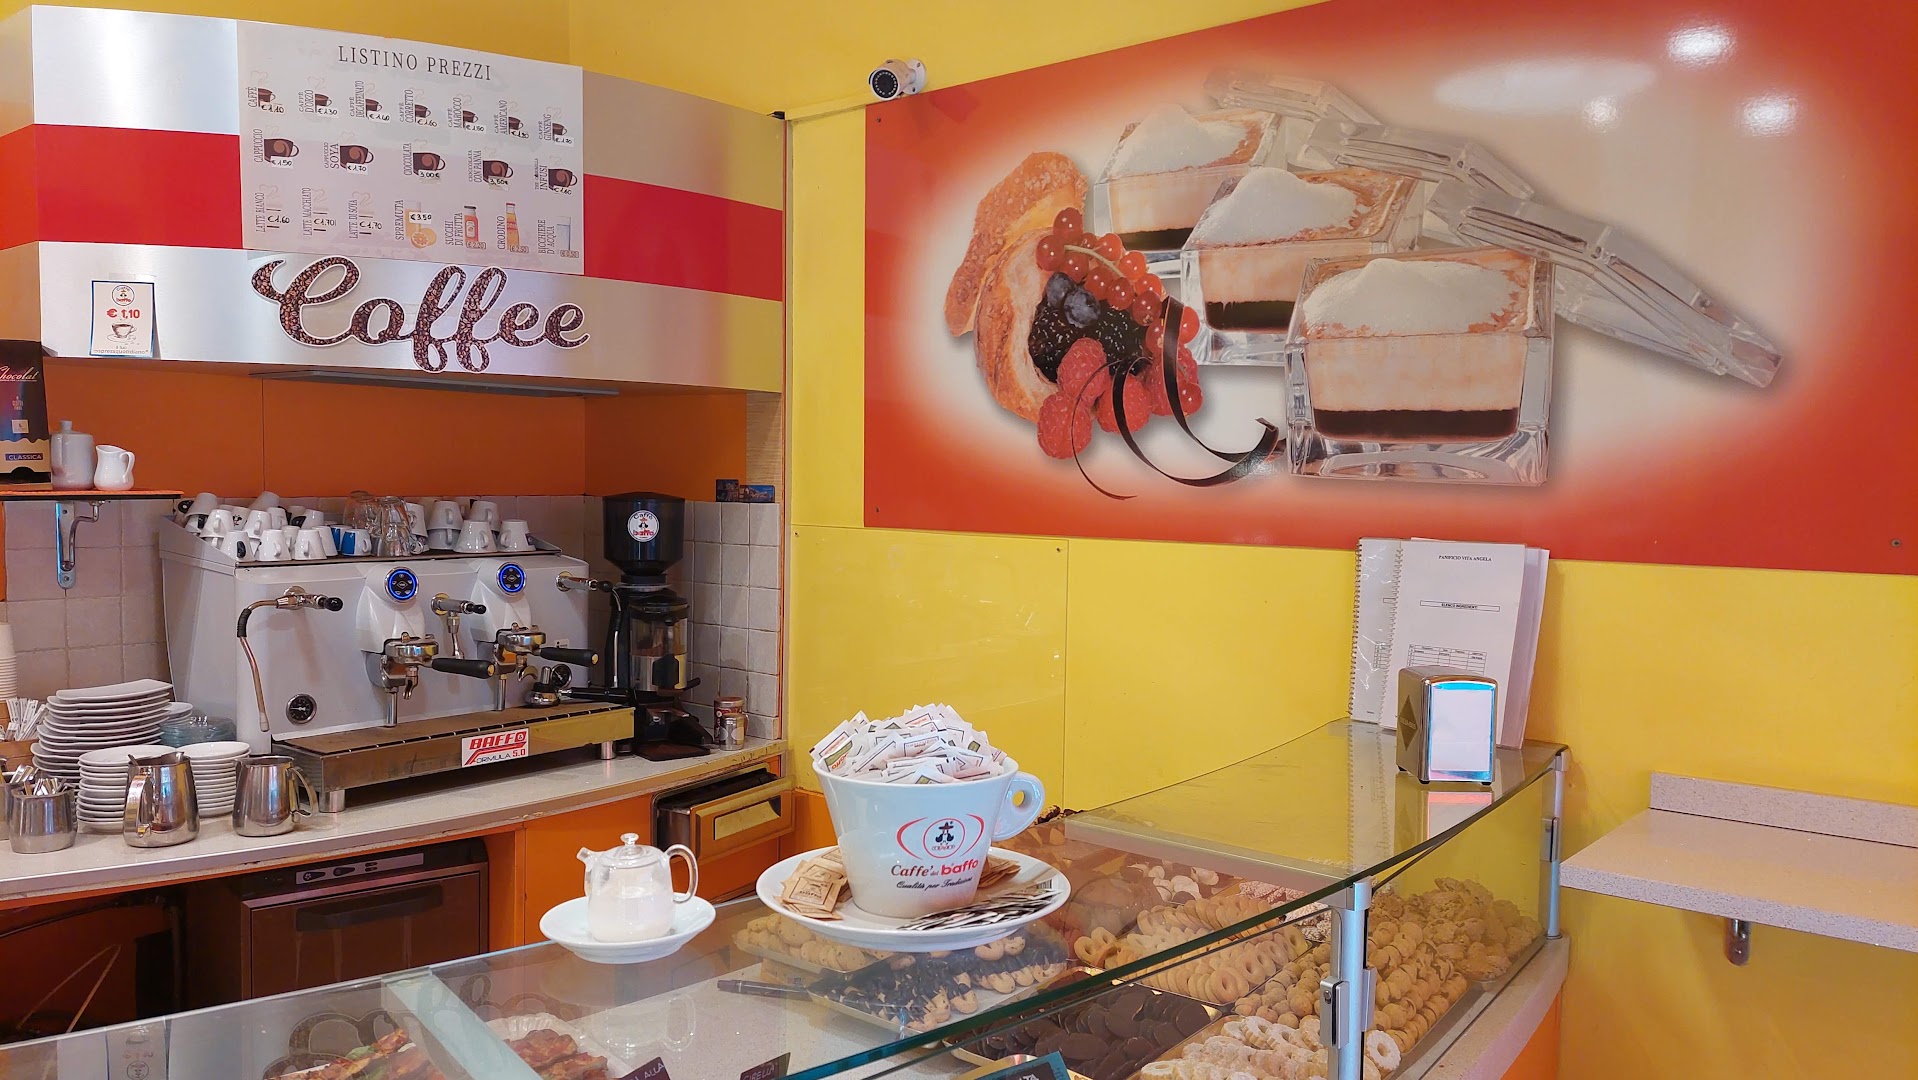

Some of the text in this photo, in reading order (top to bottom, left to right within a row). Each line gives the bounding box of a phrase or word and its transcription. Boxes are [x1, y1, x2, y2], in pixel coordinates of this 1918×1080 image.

[338, 45, 490, 80] LISTINO PREZZI
[355, 80, 365, 118] DECAFFEINATO
[404, 89, 414, 123] CORRETTO
[453, 97, 462, 128] MAROCCO
[499, 100, 508, 135] AMERICANO
[543, 113, 552, 141] GINSENG
[253, 128, 263, 163] CAPPUCCIO
[330, 142, 340, 169] SOYA
[403, 143, 412, 176] CIOCCOLATA
[474, 150, 482, 183] CON PANNA
[539, 165, 548, 191] INFUSI
[255, 192, 266, 233] LATTE BIANCO
[302, 187, 312, 236] LATTE MACCHIATO
[349, 199, 357, 213] SOYA
[394, 199, 404, 241] SPREMUTA
[349, 221, 358, 239] LATTE
[445, 220, 454, 246] SUCCHI
[454, 212, 463, 238] FRUTTA
[498, 215, 506, 250] CRODINO
[106, 308, 140, 319] € 1,10
[251, 255, 590, 373] Coffee
[512, 749, 526, 757] 5.0
[941, 859, 979, 875] baffo
